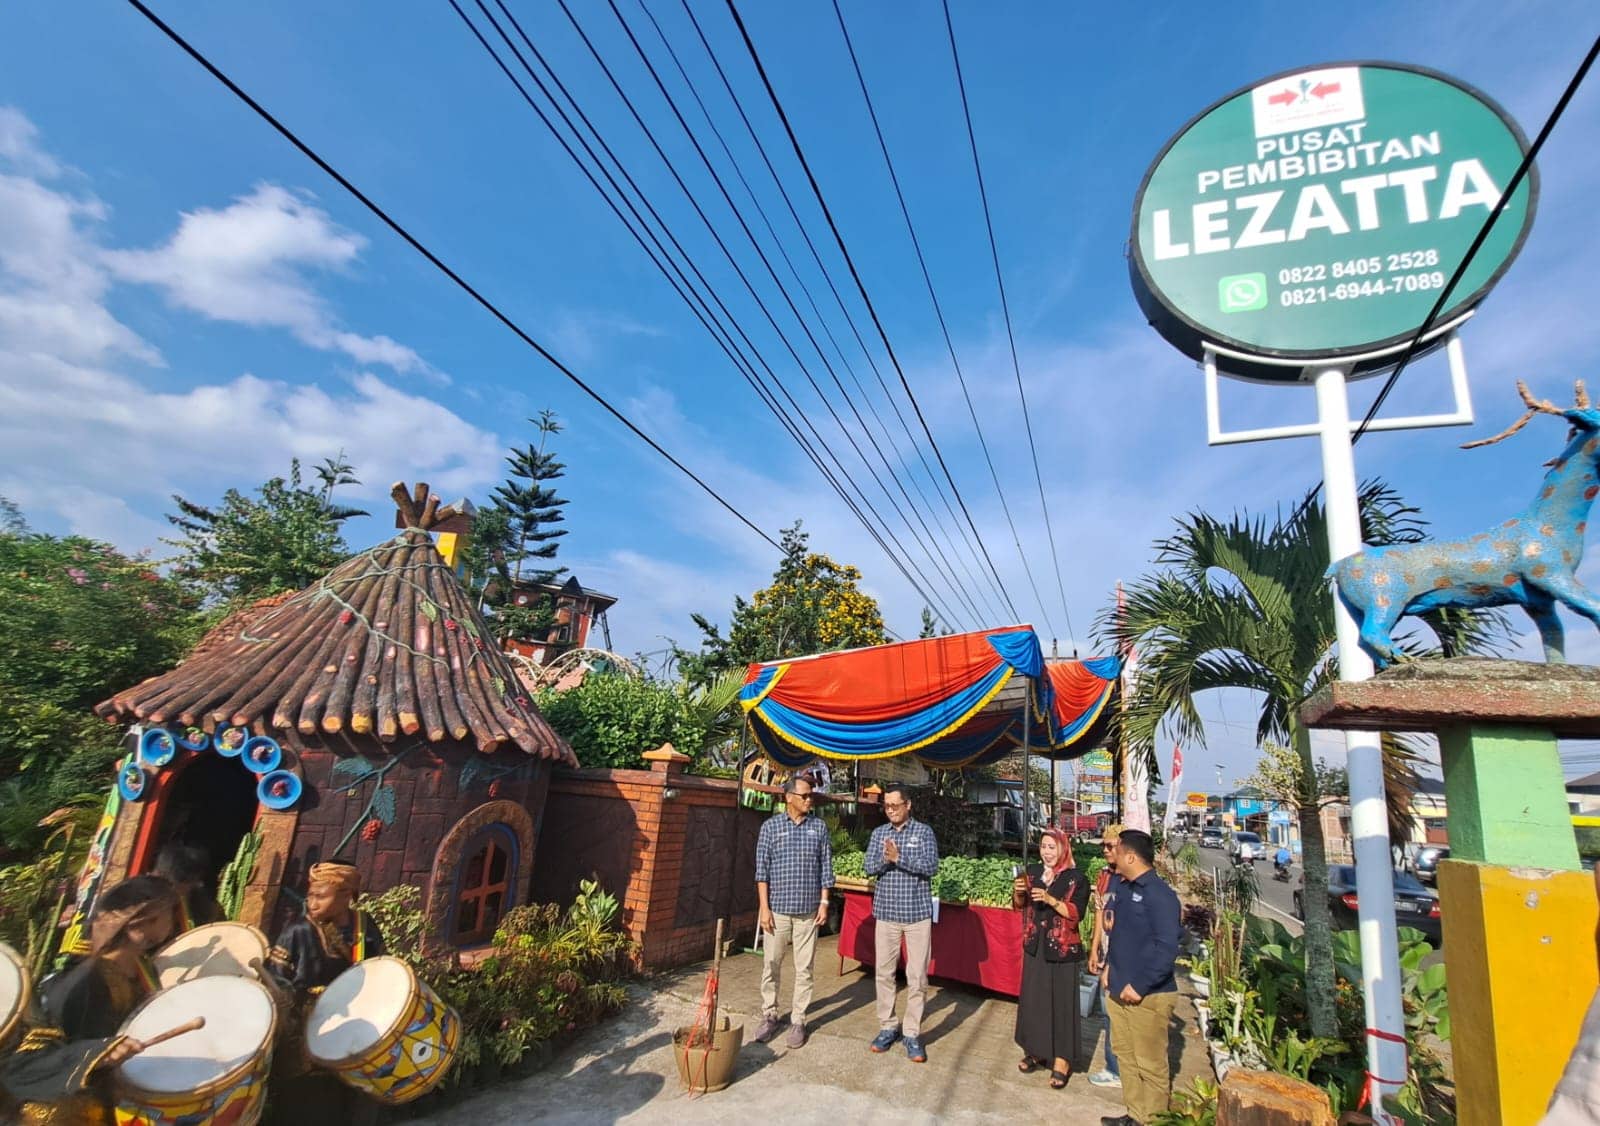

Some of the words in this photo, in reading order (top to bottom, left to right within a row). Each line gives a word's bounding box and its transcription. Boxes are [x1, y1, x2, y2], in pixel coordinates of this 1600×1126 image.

[1257, 121, 1367, 159] PUSAT
[1198, 132, 1441, 192] PEMBIBITAN
[1153, 158, 1509, 260] LEZATTA
[1279, 265, 1326, 285] 0822
[1332, 258, 1381, 278] 8405
[1387, 250, 1438, 270] 2528
[1280, 272, 1444, 307] 0821-6944-7089
